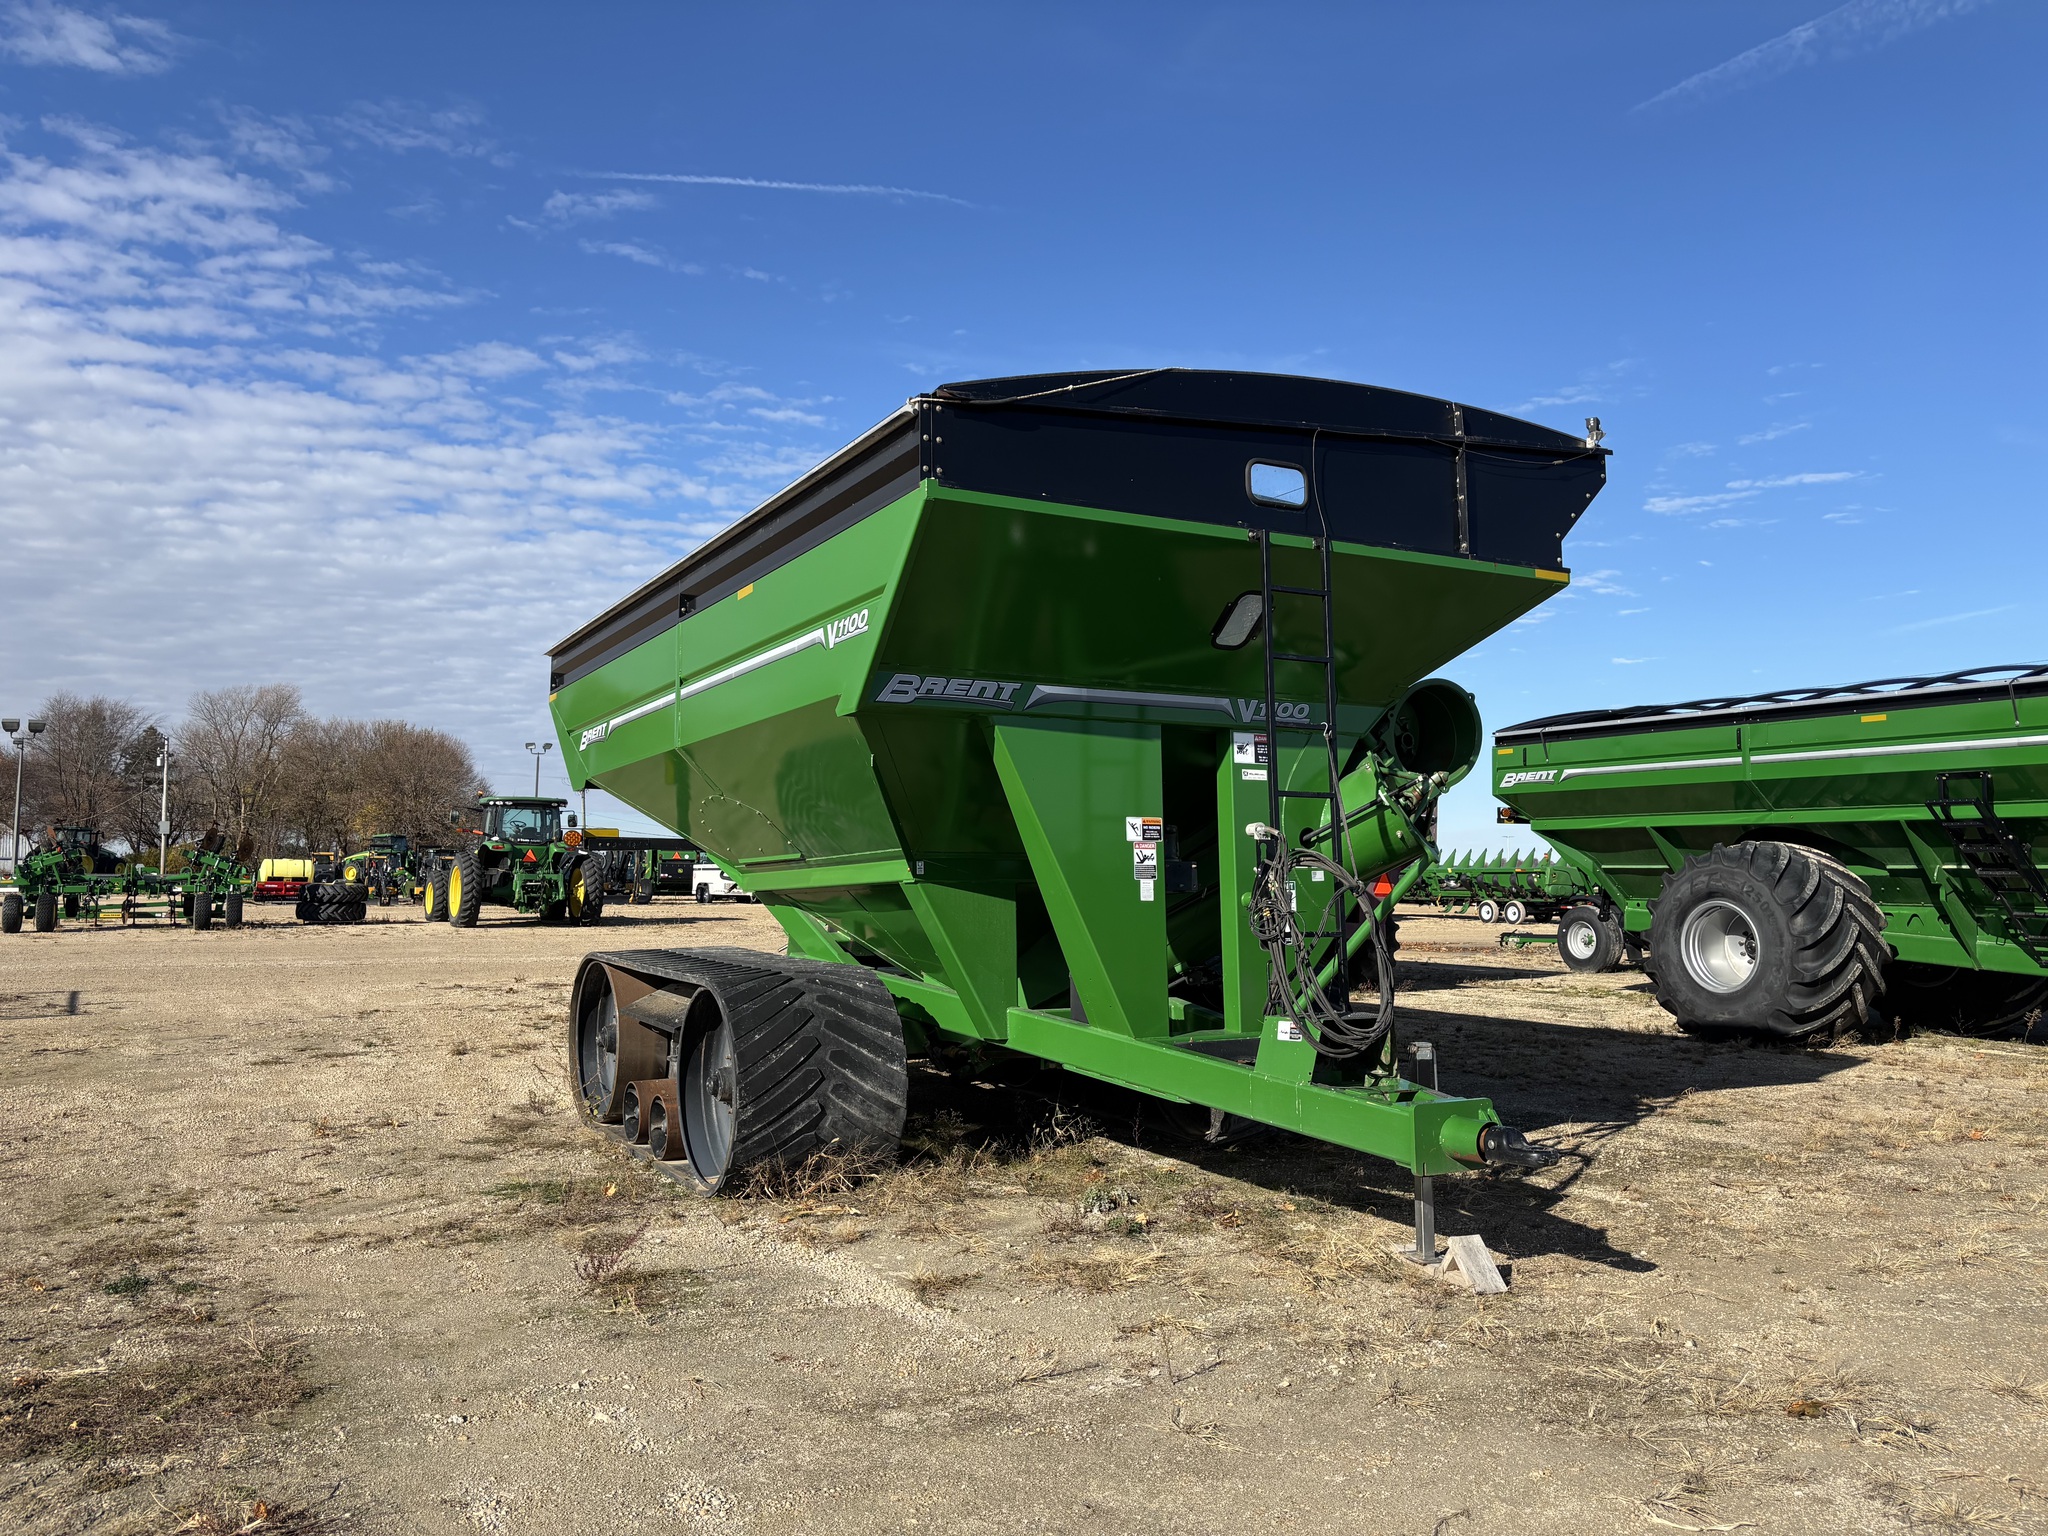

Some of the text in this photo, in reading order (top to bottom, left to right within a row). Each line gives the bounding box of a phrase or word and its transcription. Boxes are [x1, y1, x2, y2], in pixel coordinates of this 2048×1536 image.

[827, 608, 869, 649] V1100
[876, 673, 1022, 704] BRENT
[579, 722, 608, 751] BRENT
[1499, 769, 1558, 788] BRENT
